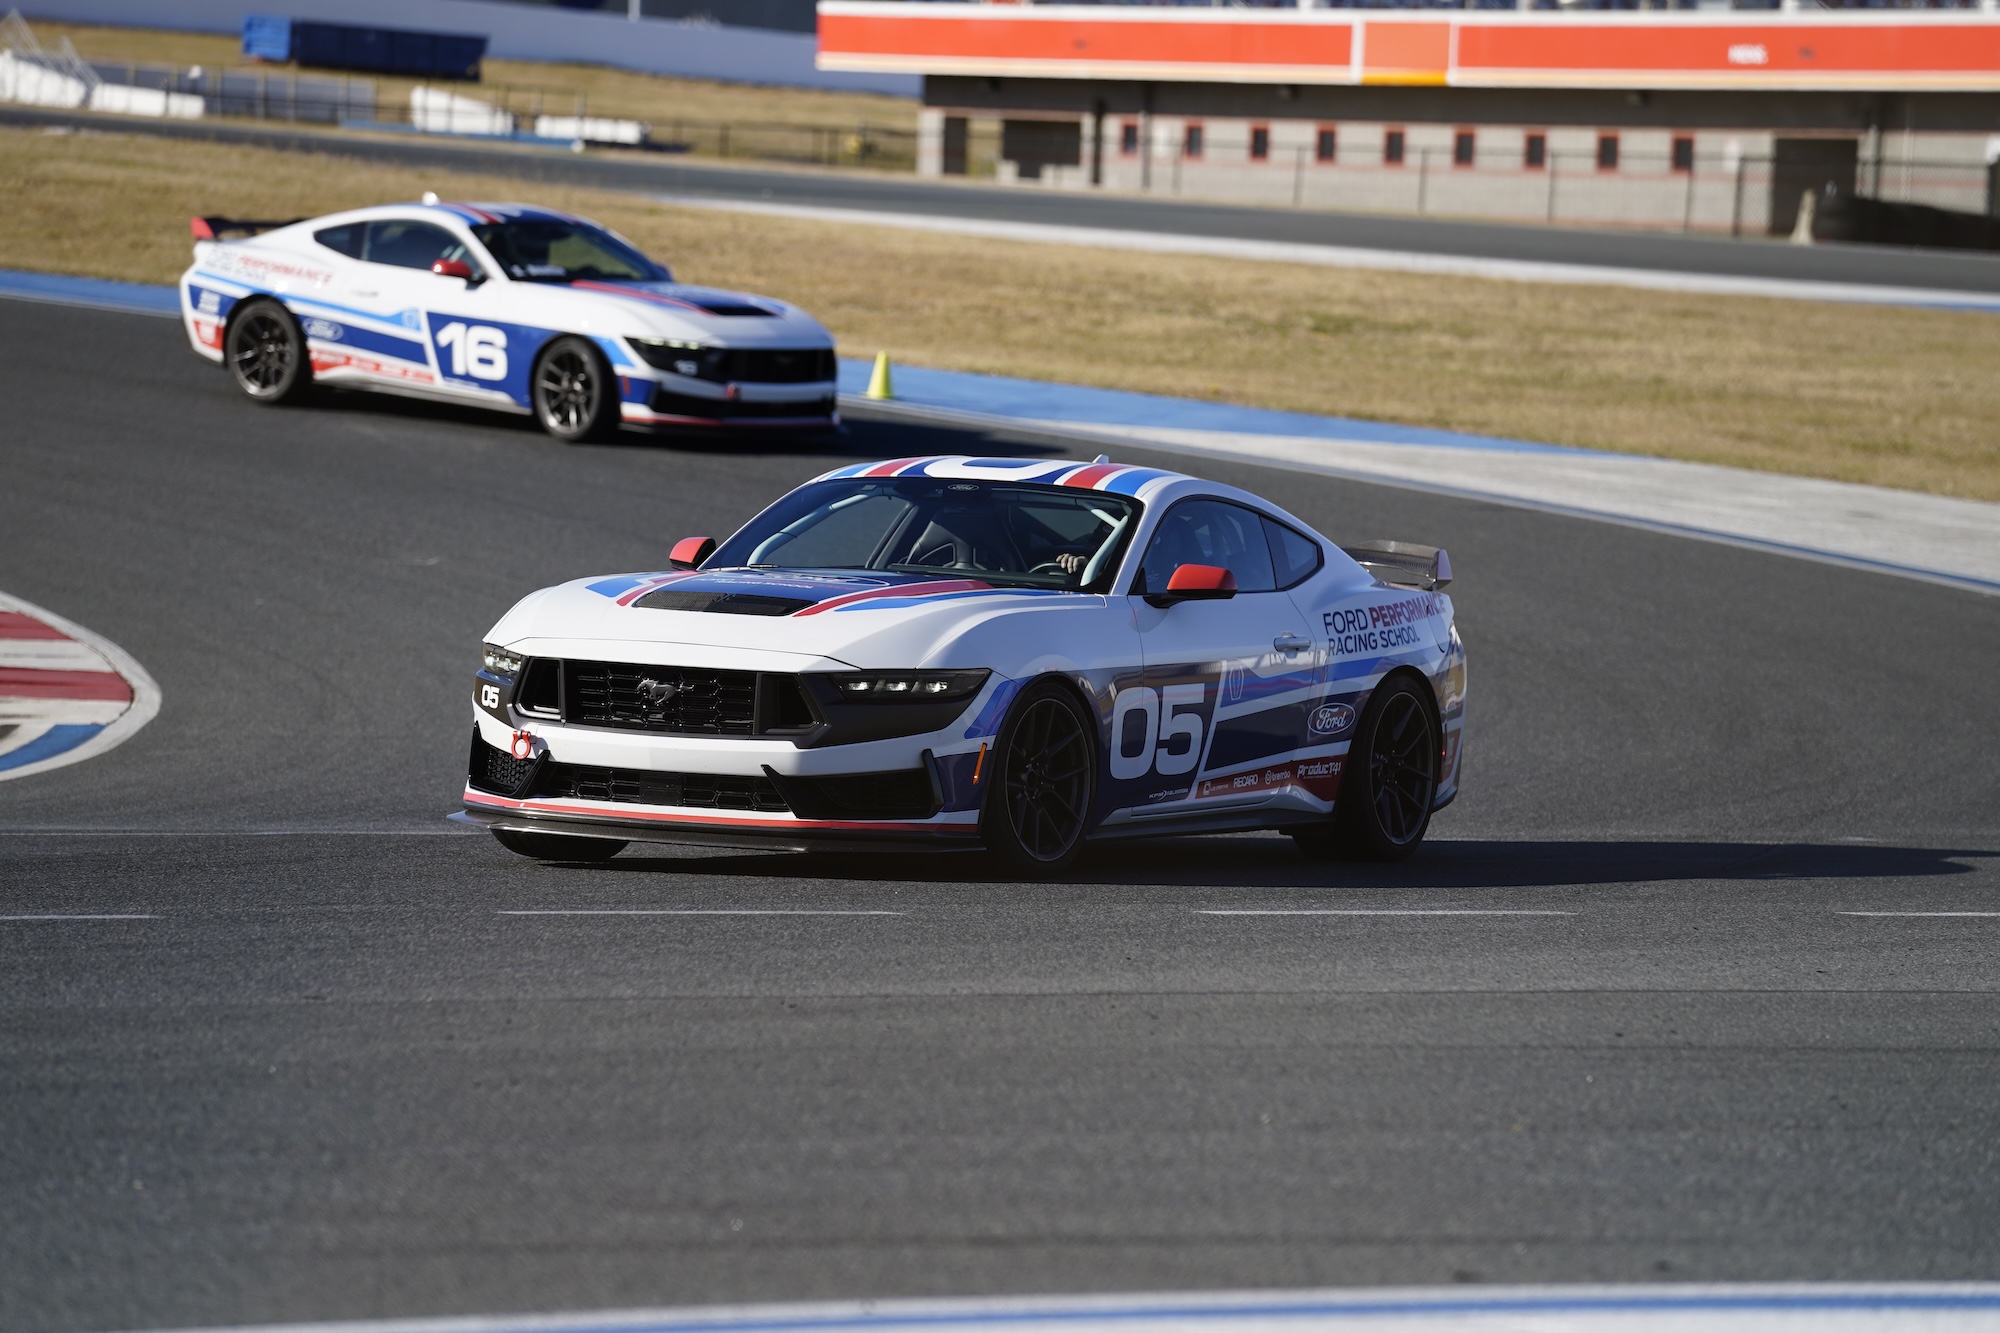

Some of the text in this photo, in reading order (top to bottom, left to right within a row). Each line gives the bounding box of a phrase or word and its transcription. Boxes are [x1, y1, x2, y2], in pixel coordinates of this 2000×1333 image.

[435, 321, 508, 382] 16
[1322, 593, 1446, 636] FORD PERFORMANCE
[1328, 625, 1421, 656] RACING SCHOOL
[481, 684, 500, 709] 05
[1110, 683, 1205, 780] 05
[1315, 706, 1347, 730] Ford
[1233, 773, 1259, 788] RECARO
[1271, 770, 1291, 782] brembo
